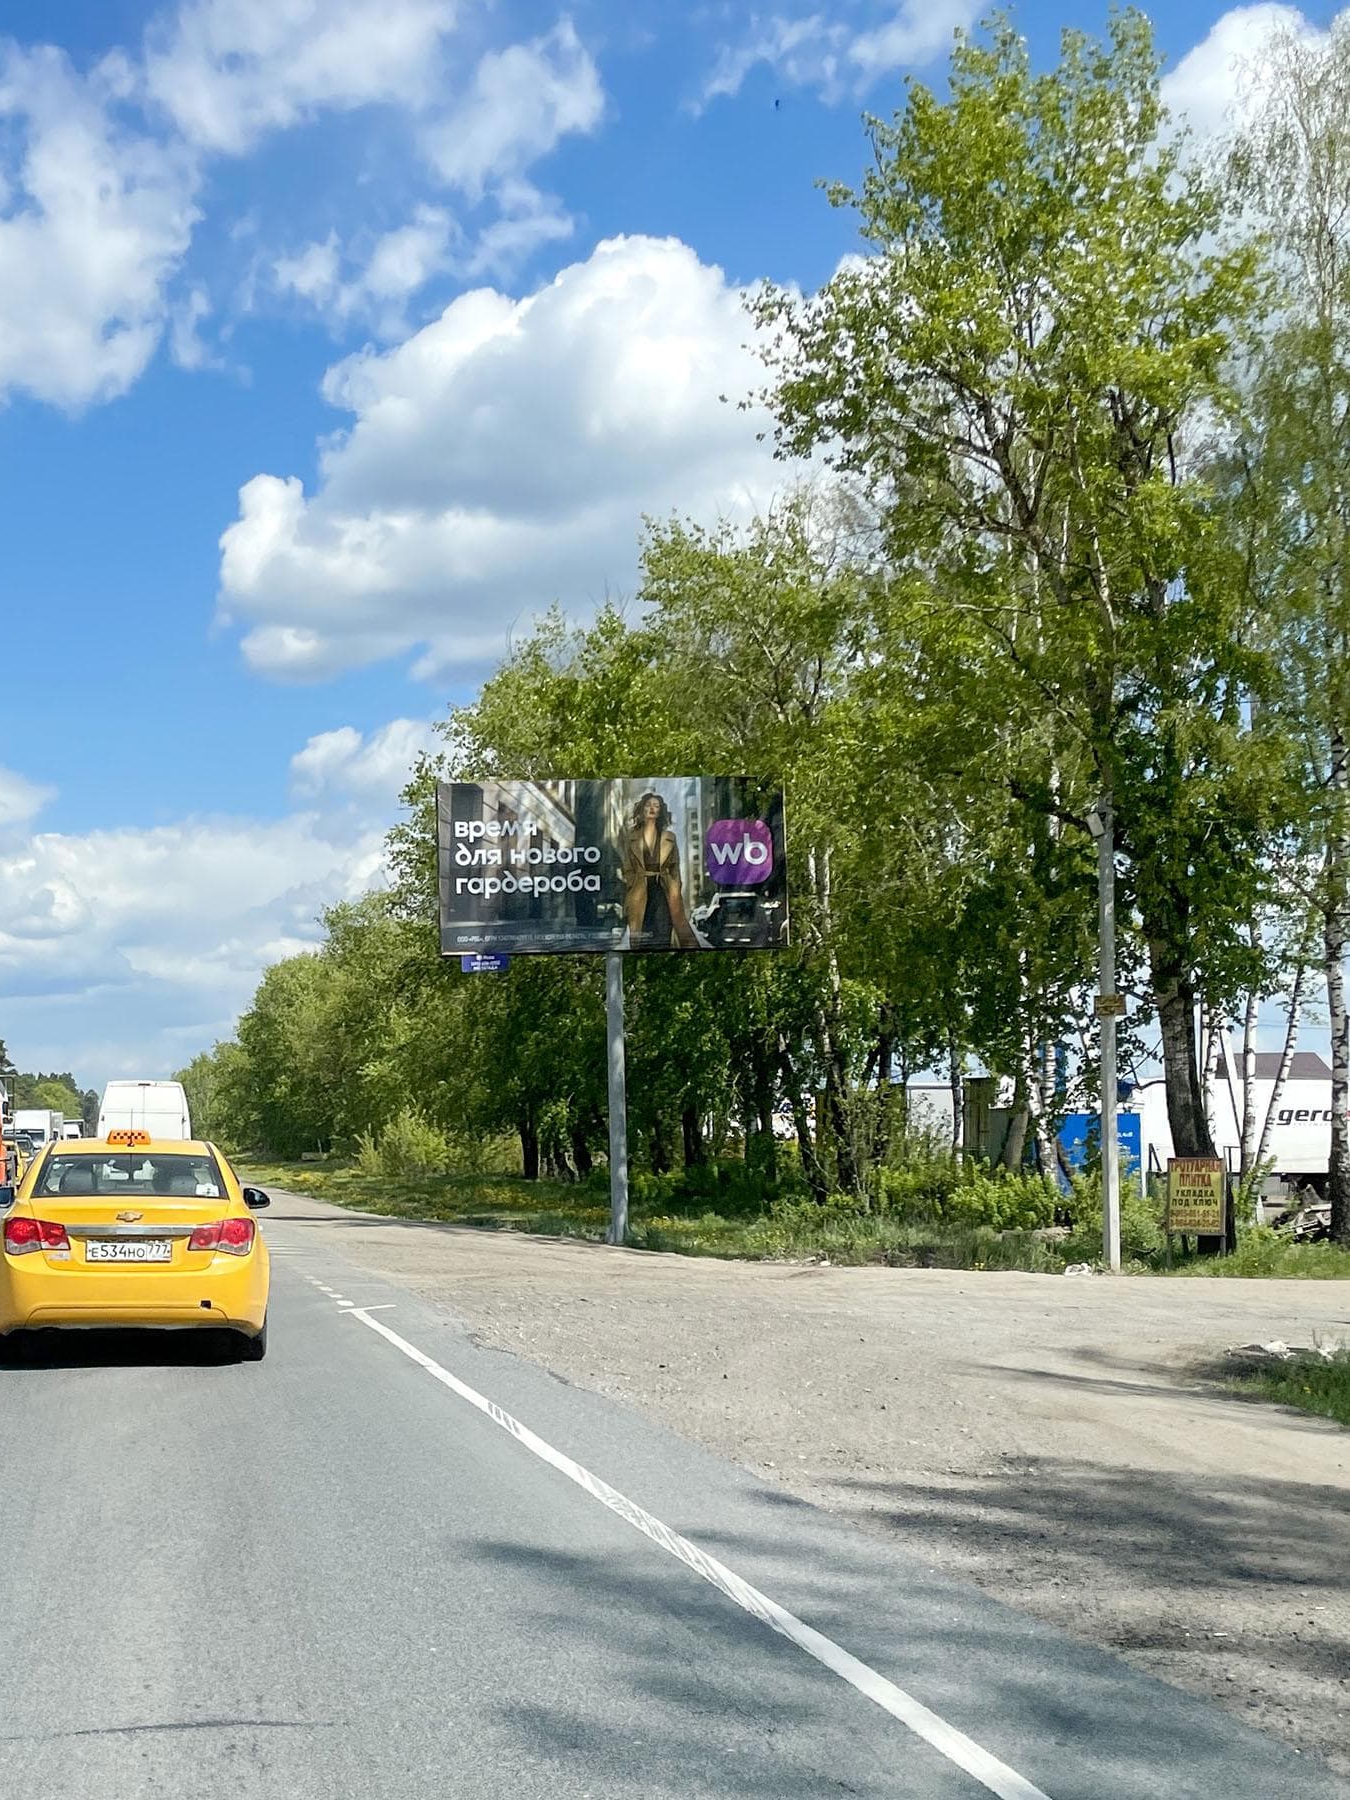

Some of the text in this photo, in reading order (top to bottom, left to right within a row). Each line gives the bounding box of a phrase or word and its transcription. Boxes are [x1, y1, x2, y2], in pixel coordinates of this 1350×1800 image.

[454, 819, 537, 843] время
[454, 842, 601, 866] для нового
[710, 832, 768, 865] wb
[455, 869, 601, 899] гардероба
[1171, 1198, 1218, 1207] ПОД КЛЮЧ
[1175, 1189, 1215, 1197] УКЛАДКА
